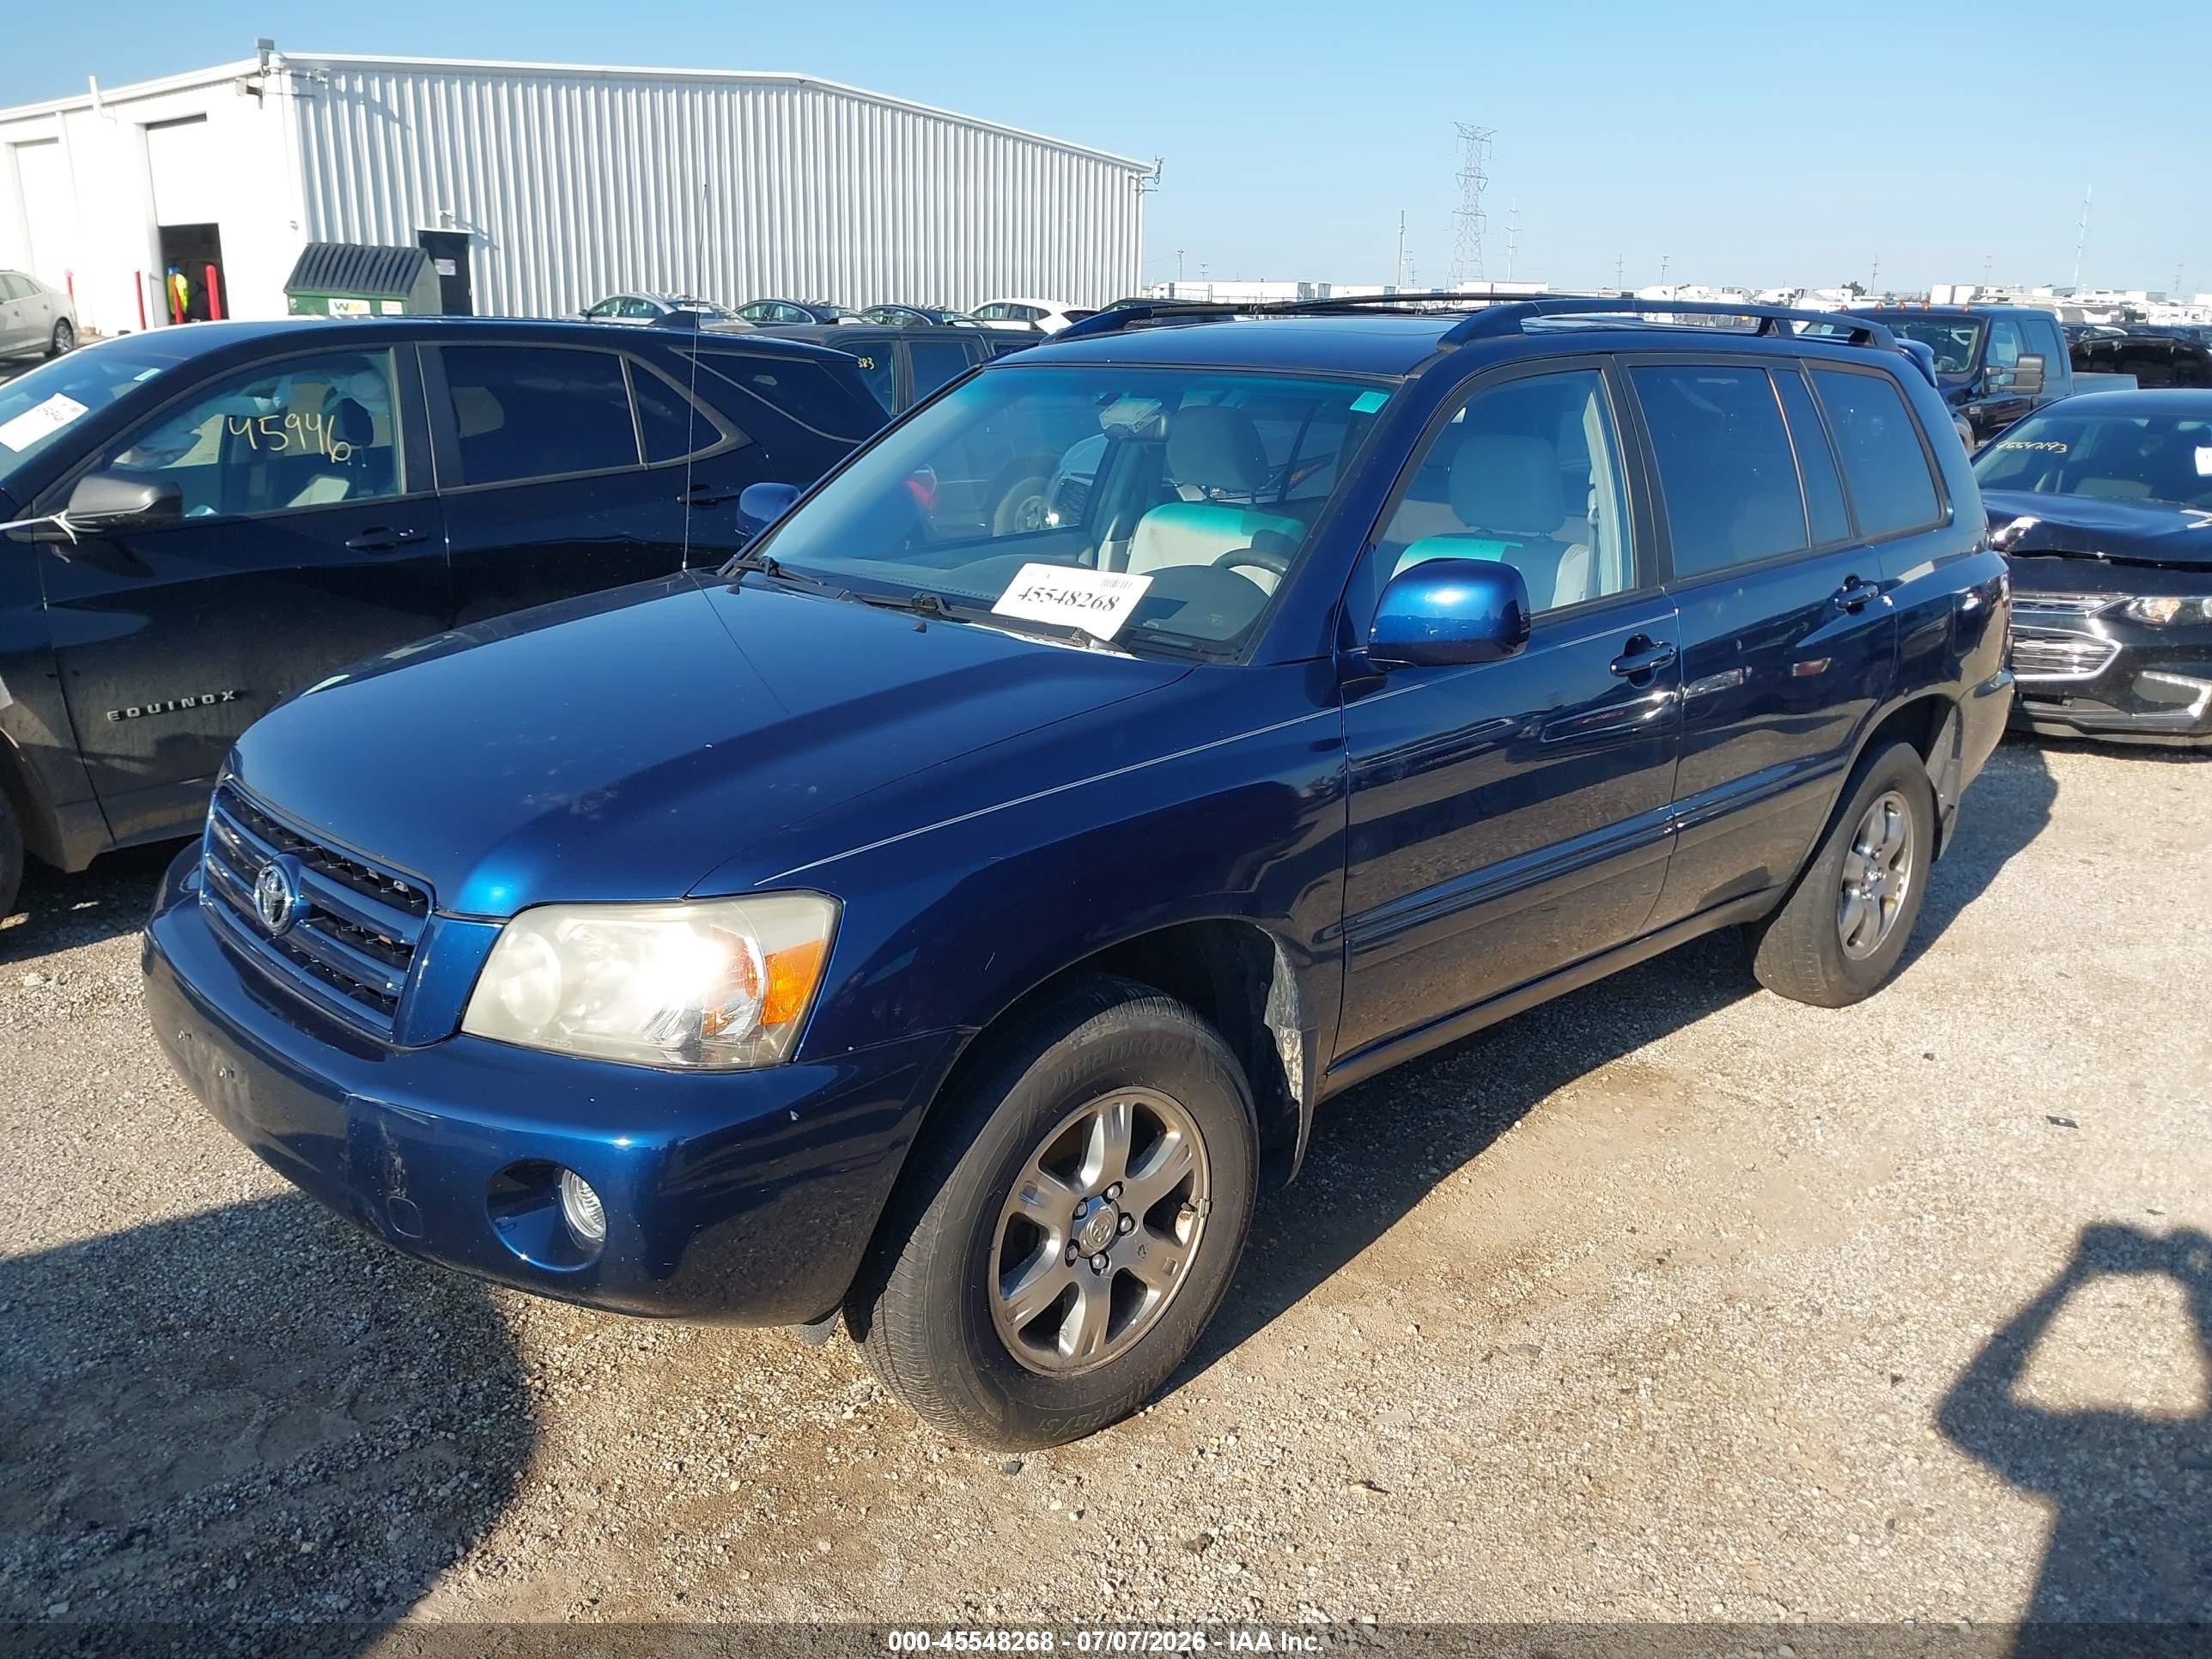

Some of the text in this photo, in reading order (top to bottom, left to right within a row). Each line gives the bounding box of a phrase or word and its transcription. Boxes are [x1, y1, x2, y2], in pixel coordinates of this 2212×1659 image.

[228, 413, 352, 464] 45946
[1017, 586, 1121, 611] 45548268
[106, 690, 235, 722] EQUINOX
